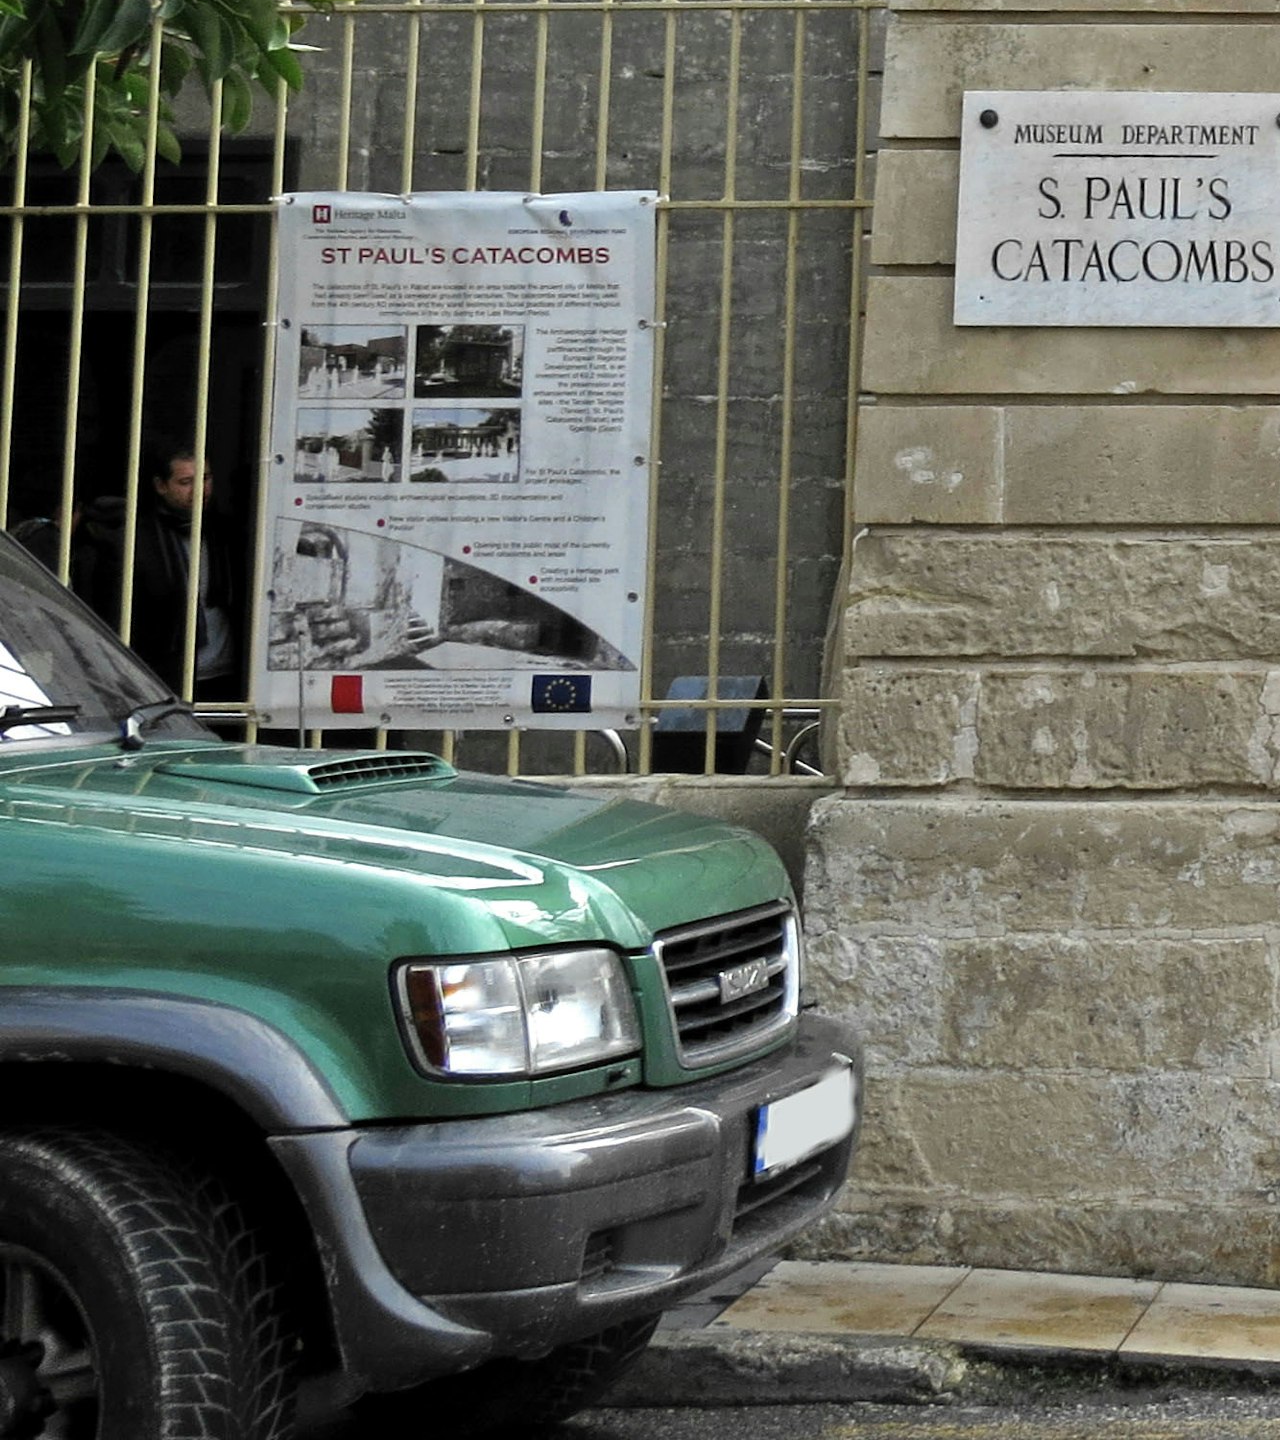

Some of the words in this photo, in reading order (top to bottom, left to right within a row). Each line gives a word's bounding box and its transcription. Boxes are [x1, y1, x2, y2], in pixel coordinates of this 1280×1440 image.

[1014, 124, 1104, 145] MUSEUM
[1122, 124, 1260, 146] DEPARTMENT
[1037, 177, 1066, 220] S.
[1084, 176, 1232, 220] PAUL'S
[378, 210, 406, 220] Malta
[321, 247, 352, 264] ST
[358, 247, 446, 264] PAUL'S
[452, 247, 610, 264] CATACOMBS
[991, 239, 1275, 283] CATACOMBS
